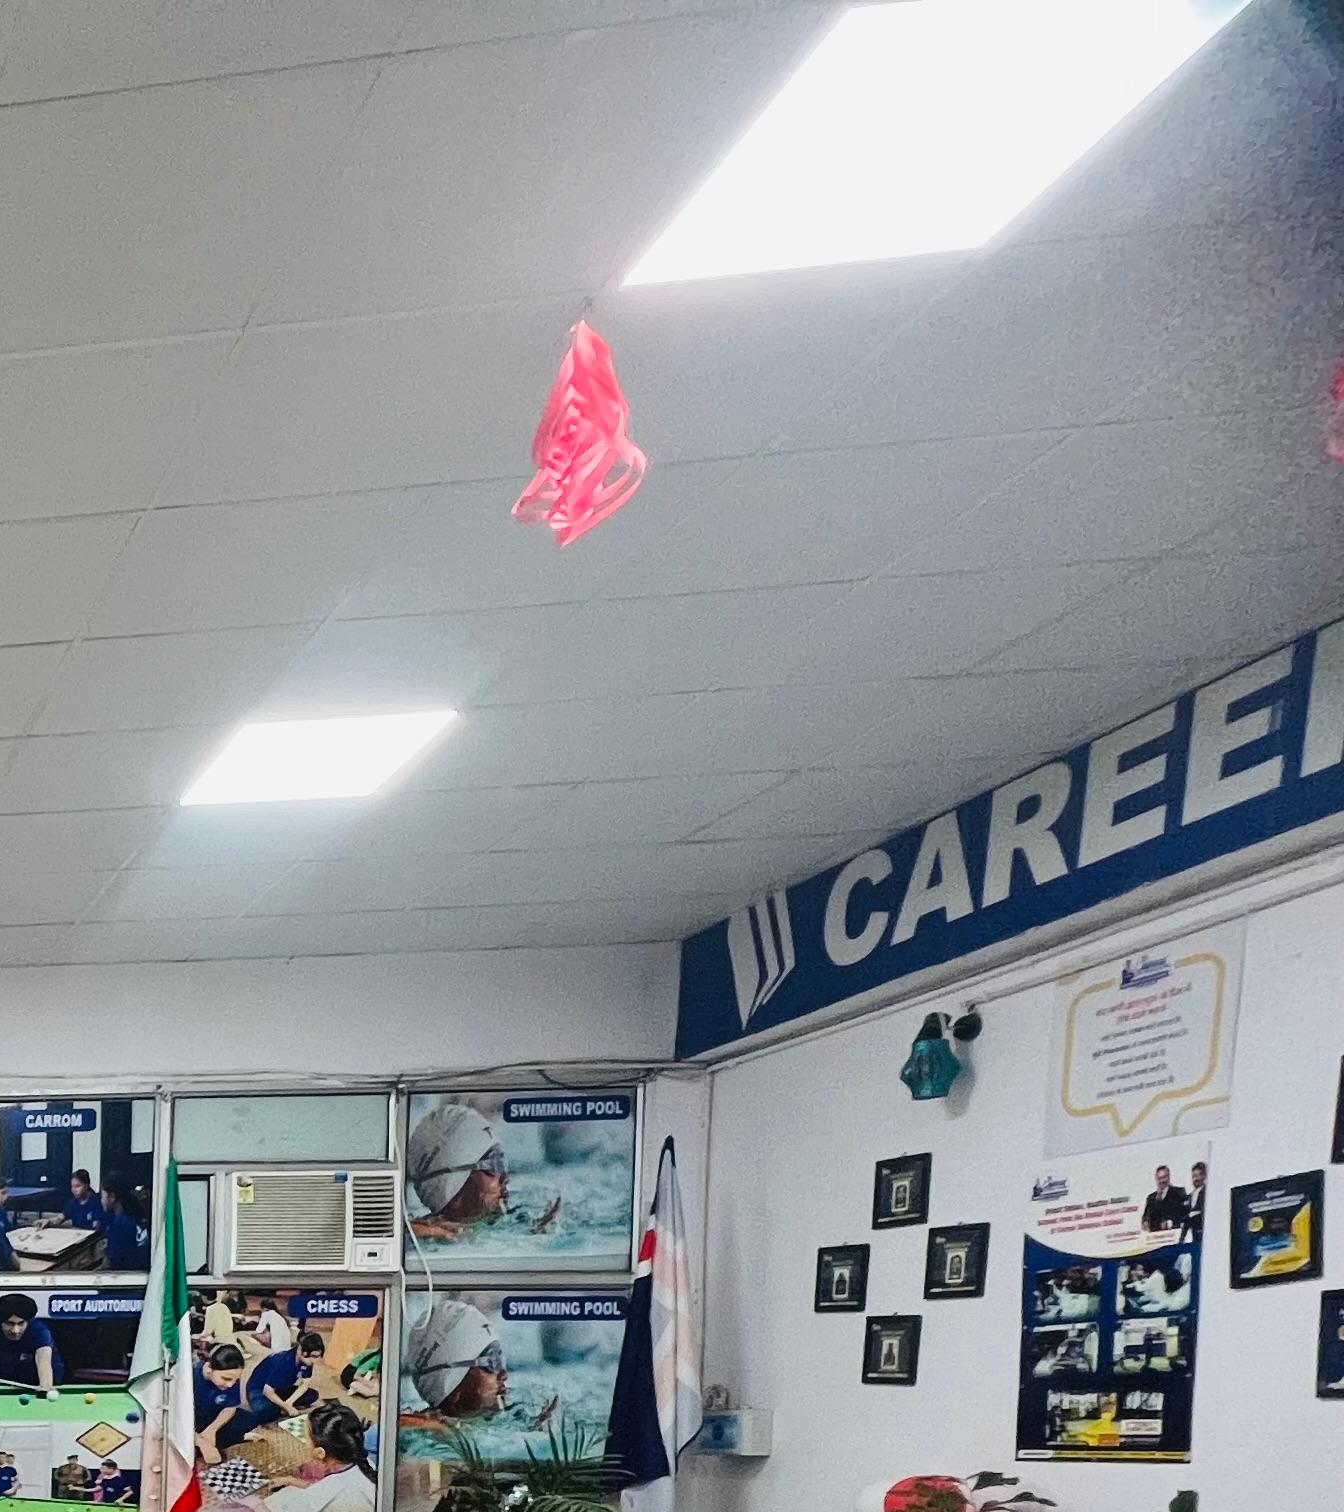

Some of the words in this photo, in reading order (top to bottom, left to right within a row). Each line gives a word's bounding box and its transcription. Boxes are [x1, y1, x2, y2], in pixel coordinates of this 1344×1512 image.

[510, 1102, 582, 1118] SWIMMING
[586, 1101, 624, 1115] POOL
[25, 1113, 83, 1128] CARROM
[51, 1299, 84, 1313] SPORT
[306, 1299, 359, 1314] CHESS
[508, 1301, 581, 1316] SWIMMING
[584, 1301, 621, 1316] POOL
